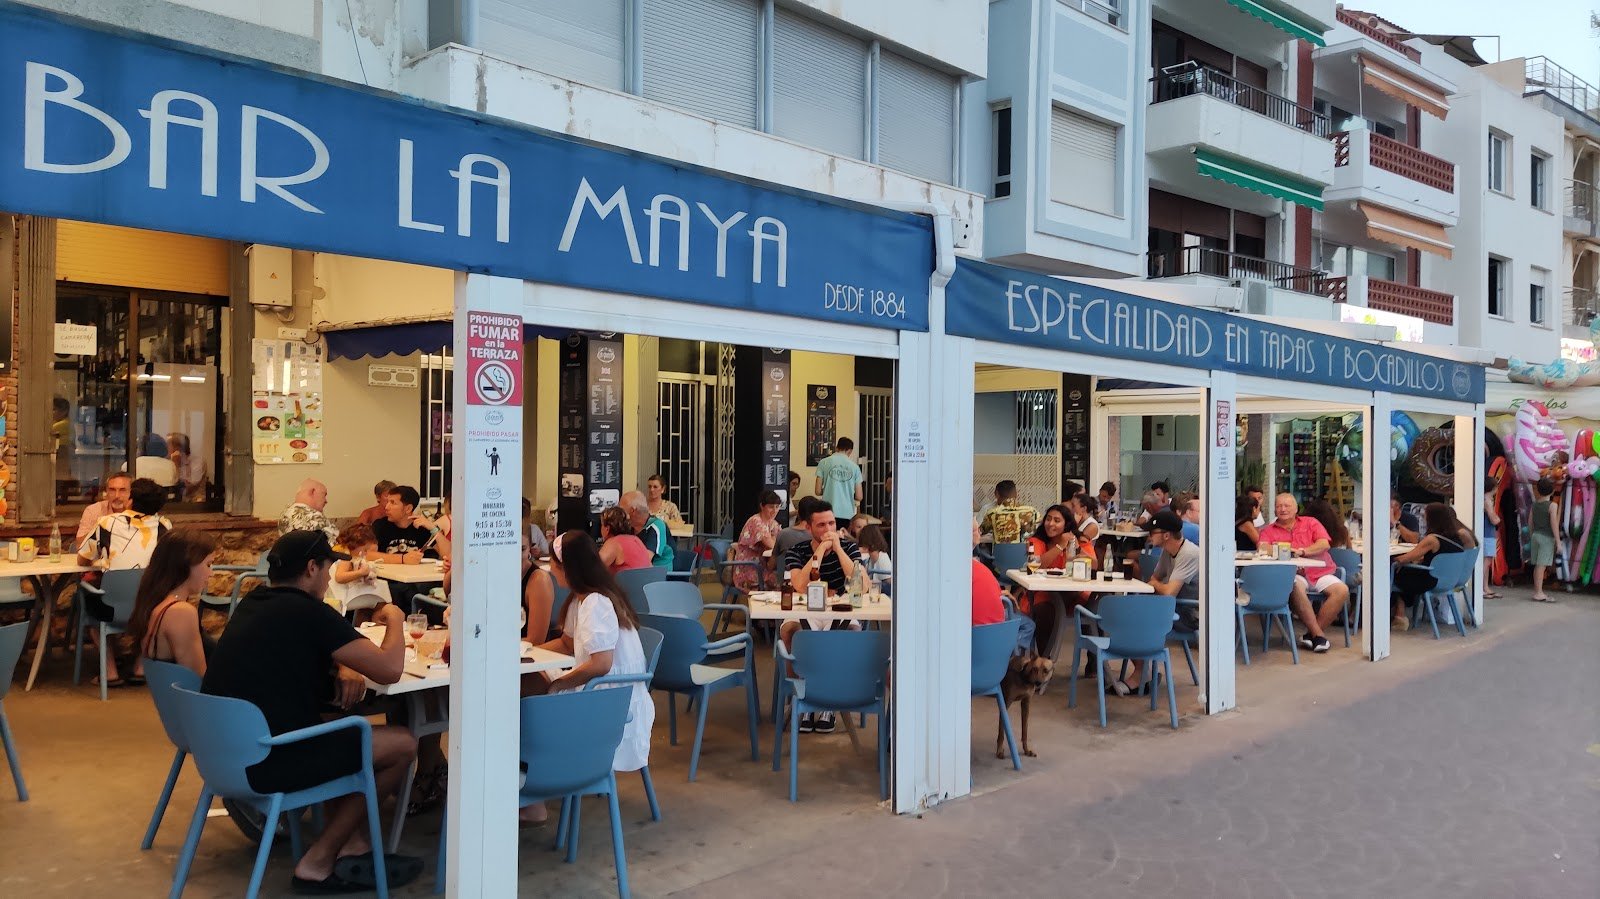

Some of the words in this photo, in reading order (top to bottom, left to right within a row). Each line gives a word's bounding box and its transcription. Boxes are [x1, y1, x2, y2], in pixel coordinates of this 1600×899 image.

[24, 61, 330, 214] BAR
[398, 138, 511, 243] LA
[557, 176, 788, 288] MAYA
[824, 282, 864, 315] DESDE
[869, 289, 907, 319] 1884
[469, 314, 519, 327] PROHIBIDO
[470, 325, 519, 341] FUMAR
[1004, 280, 1213, 358] ESPECIALIDAD
[1224, 322, 1250, 365] EN
[1259, 329, 1316, 375] TAPAS
[1324, 342, 1337, 377] Y
[1343, 345, 1445, 392] BOCADILLOS
[497, 340, 505, 348] la
[470, 347, 518, 360] TERRAZA
[1508, 398, 1569, 410] Rlos
[475, 521, 488, 529] 9:15
[496, 530, 514, 538] 22:30
